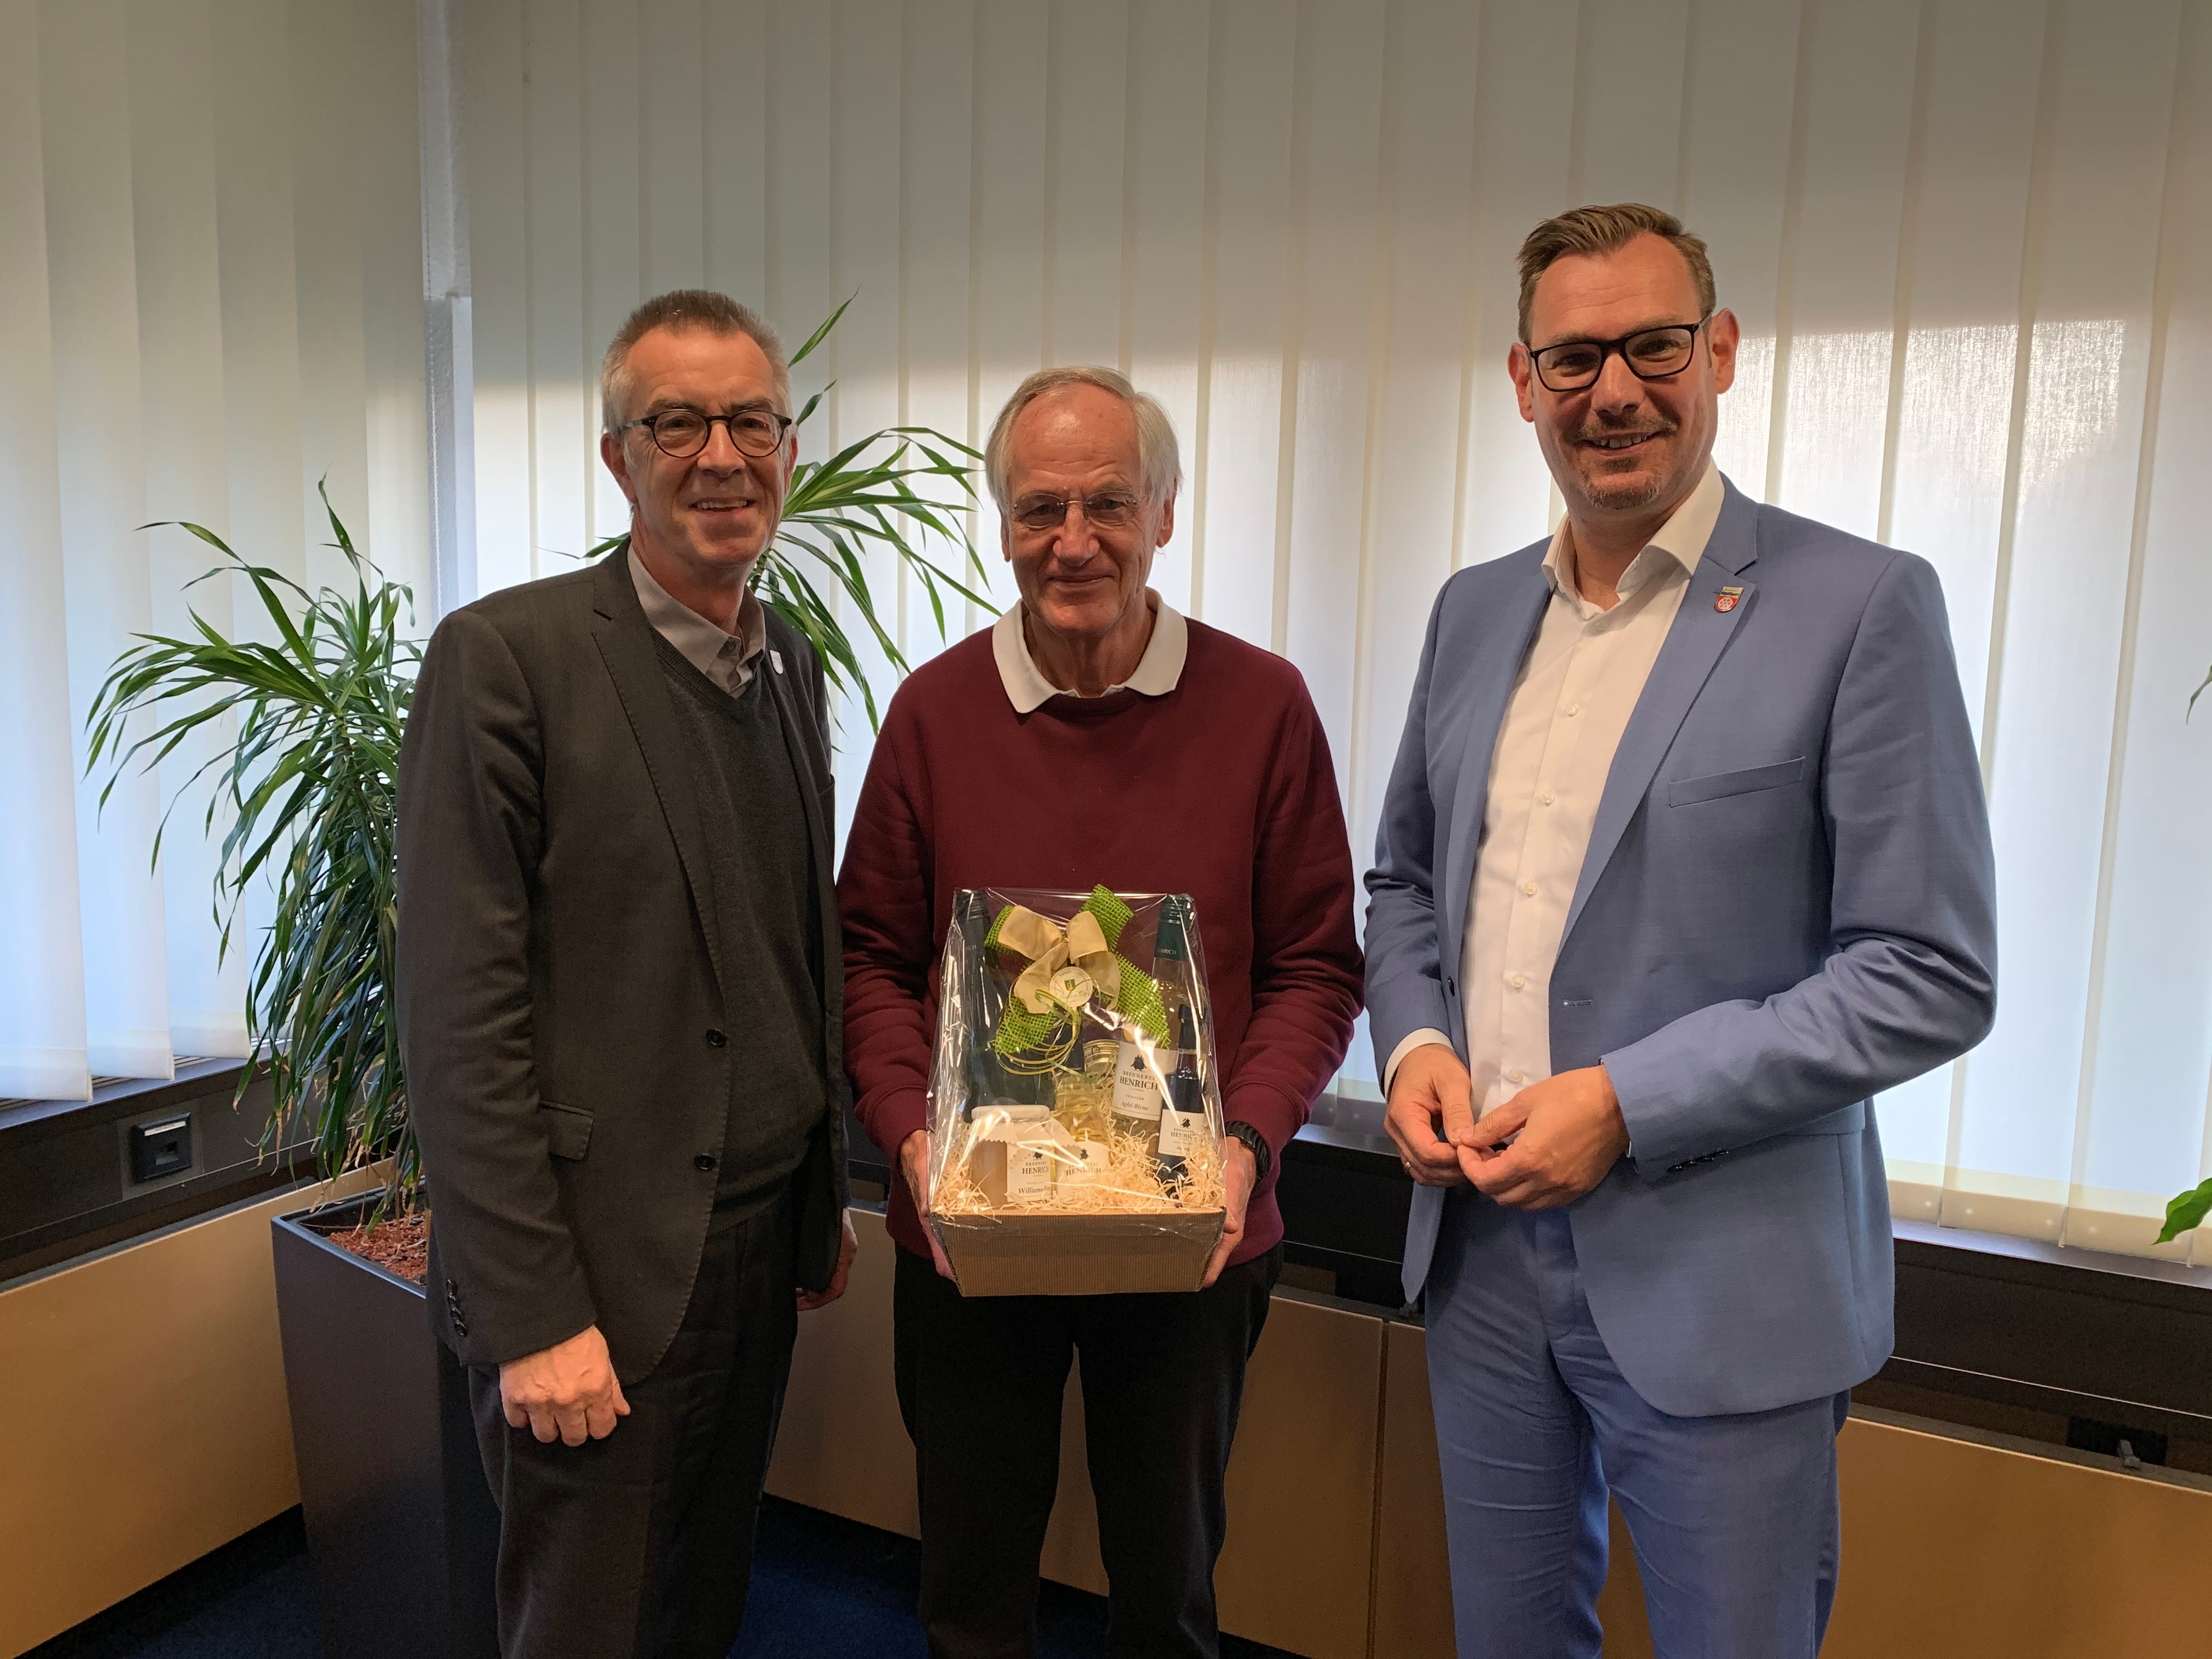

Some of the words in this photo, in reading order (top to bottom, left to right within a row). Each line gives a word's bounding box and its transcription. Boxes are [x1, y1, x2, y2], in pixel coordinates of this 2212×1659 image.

[1122, 1070, 1155, 1081] BRENNEREI
[1119, 1076, 1158, 1091] HENRICH
[1121, 1101, 1149, 1111] Apfel-Birne
